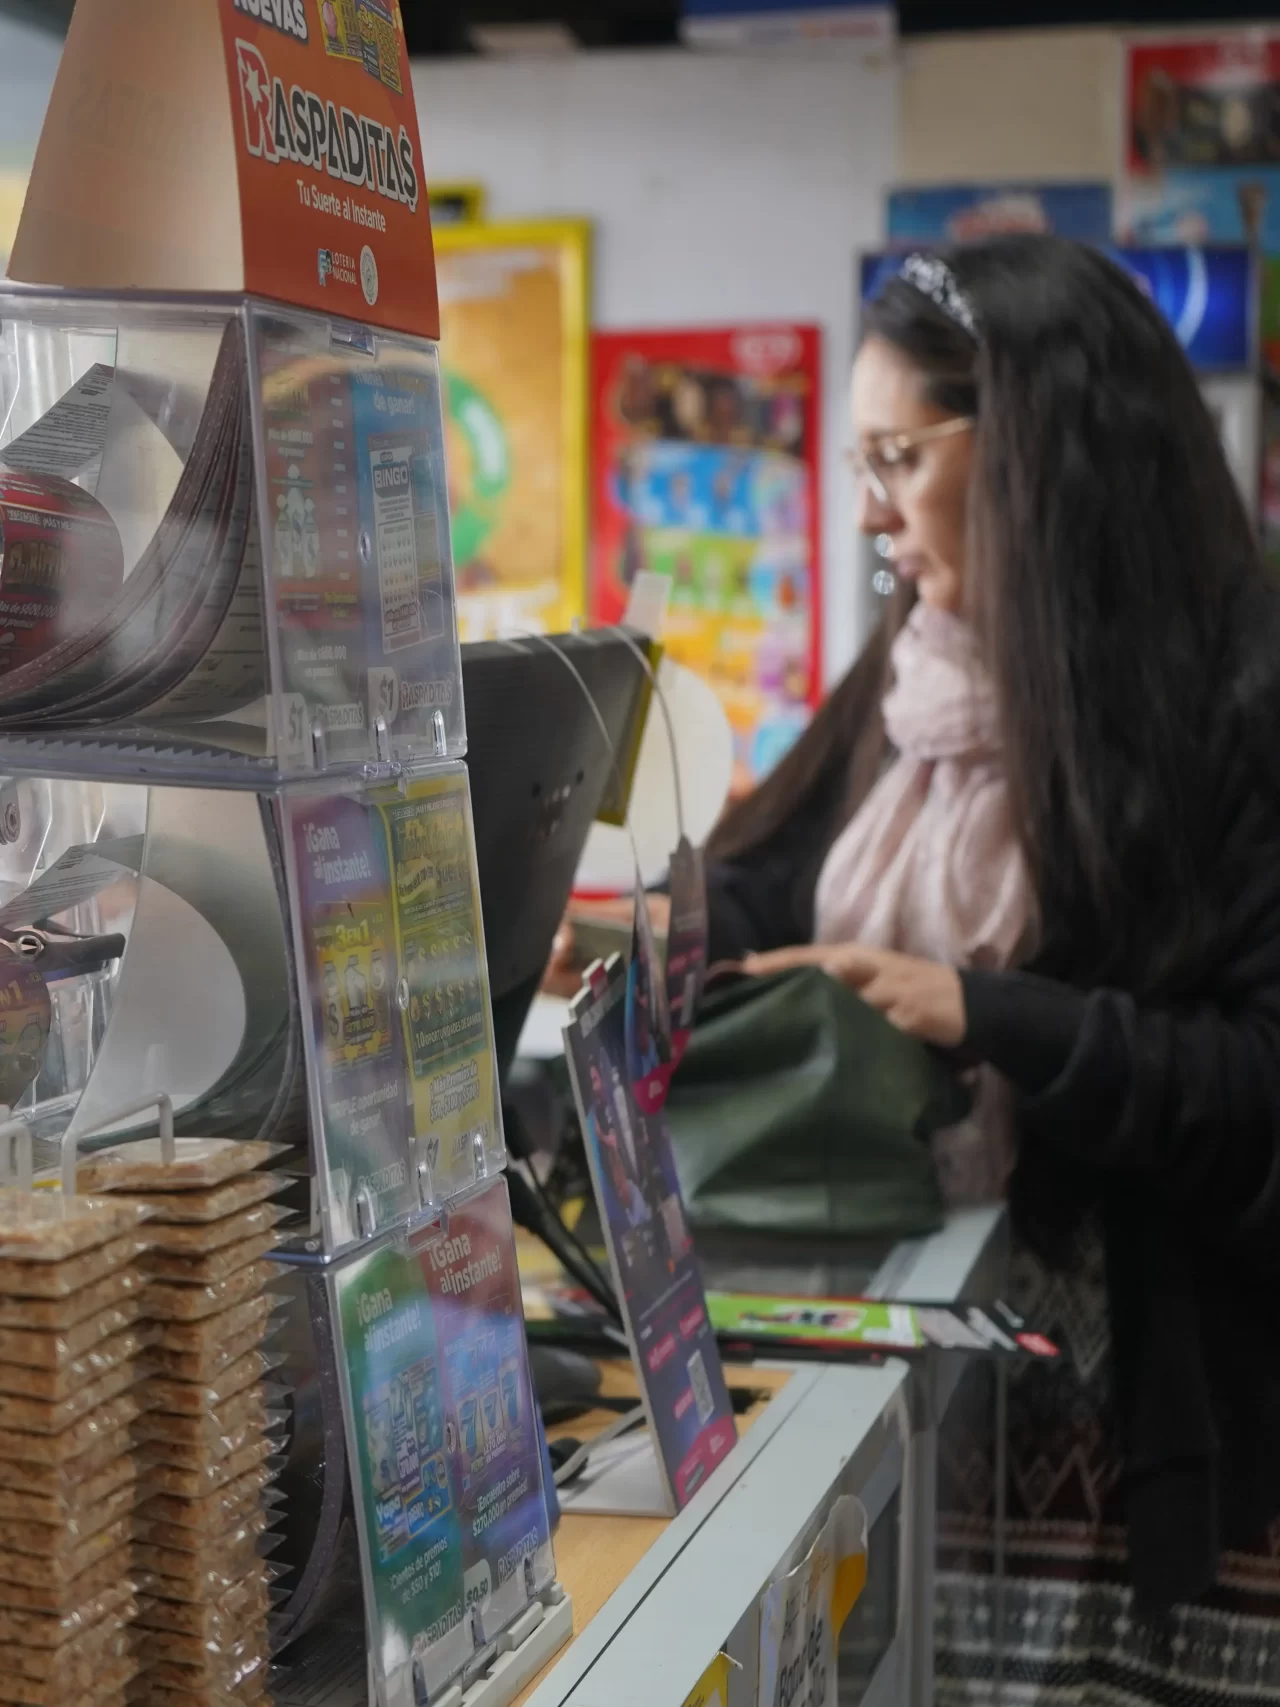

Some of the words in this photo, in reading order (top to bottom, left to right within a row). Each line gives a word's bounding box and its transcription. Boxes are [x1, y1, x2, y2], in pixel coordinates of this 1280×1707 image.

[234, 0, 308, 41] EVAS
[235, 37, 418, 213] RASPADITAS
[297, 180, 310, 205] Tu
[311, 185, 341, 217] Suerte
[343, 199, 351, 221] al
[352, 199, 386, 232] Instante
[331, 251, 356, 269] LOTERIA
[332, 266, 357, 285] NACIONAL
[374, 465, 408, 488] BINGO
[402, 677, 453, 711] RASPADITAS
[303, 822, 340, 853] ¡Gana
[8, 979, 24, 1003] 1
[428, 1233, 471, 1271] ¡Gana
[449, 1245, 502, 1295] instante!
[356, 1287, 392, 1327] ¡Gana
[371, 1302, 422, 1352] instante!
[505, 1467, 520, 1490] sobre
[473, 1505, 500, 1537] $270,000
[415, 1555, 424, 1571] de
[424, 1536, 448, 1566] premios
[465, 1578, 489, 1613] $0.50
